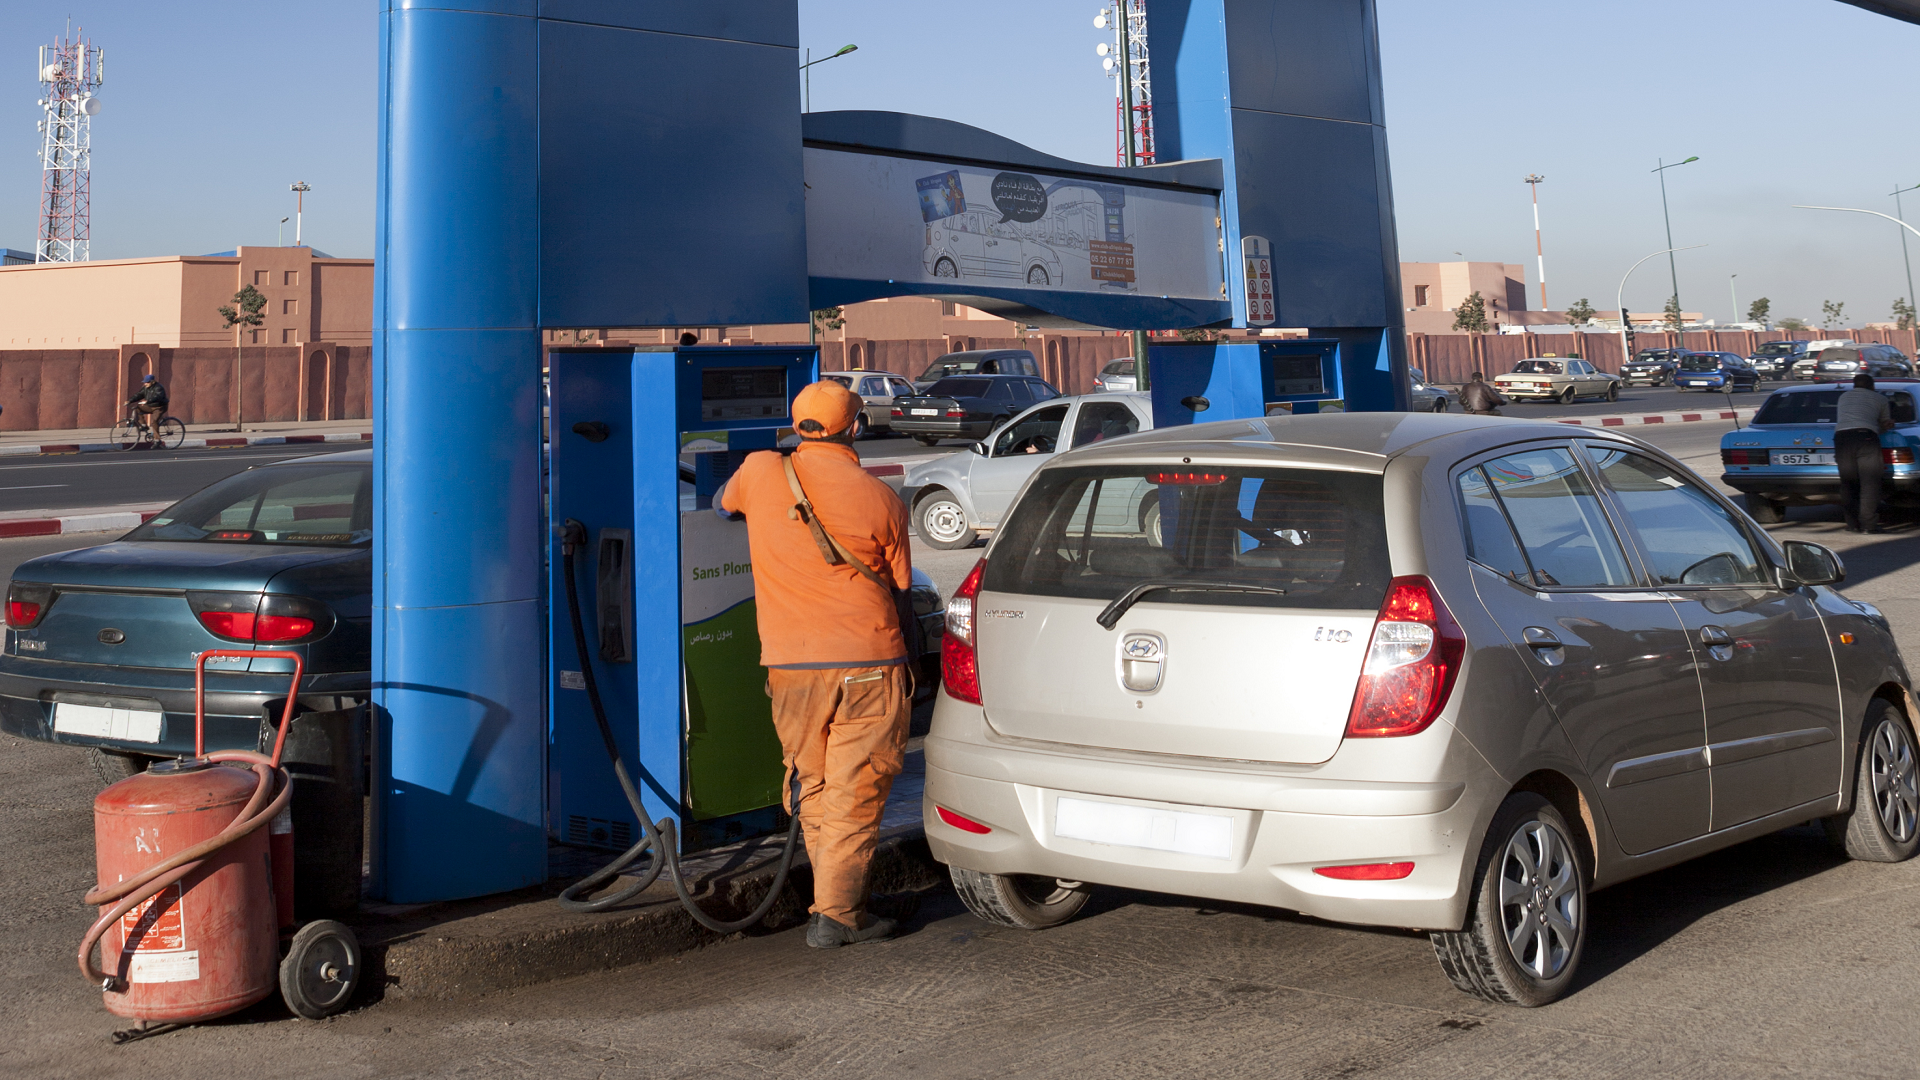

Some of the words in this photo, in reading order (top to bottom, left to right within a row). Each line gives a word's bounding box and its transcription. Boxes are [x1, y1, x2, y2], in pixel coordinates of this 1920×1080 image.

[1090, 254, 1099, 263] 05
[1099, 255, 1108, 263] 22
[1108, 256, 1116, 265] 67
[1116, 257, 1124, 265] 77
[1782, 454, 1810, 464] 9575
[692, 566, 720, 581] Sans
[723, 561, 753, 576] Plom
[984, 609, 1025, 619] HYUNDAI
[689, 631, 714, 645] رصاص
[716, 629, 733, 641] بدون
[1314, 626, 1353, 643] i10
